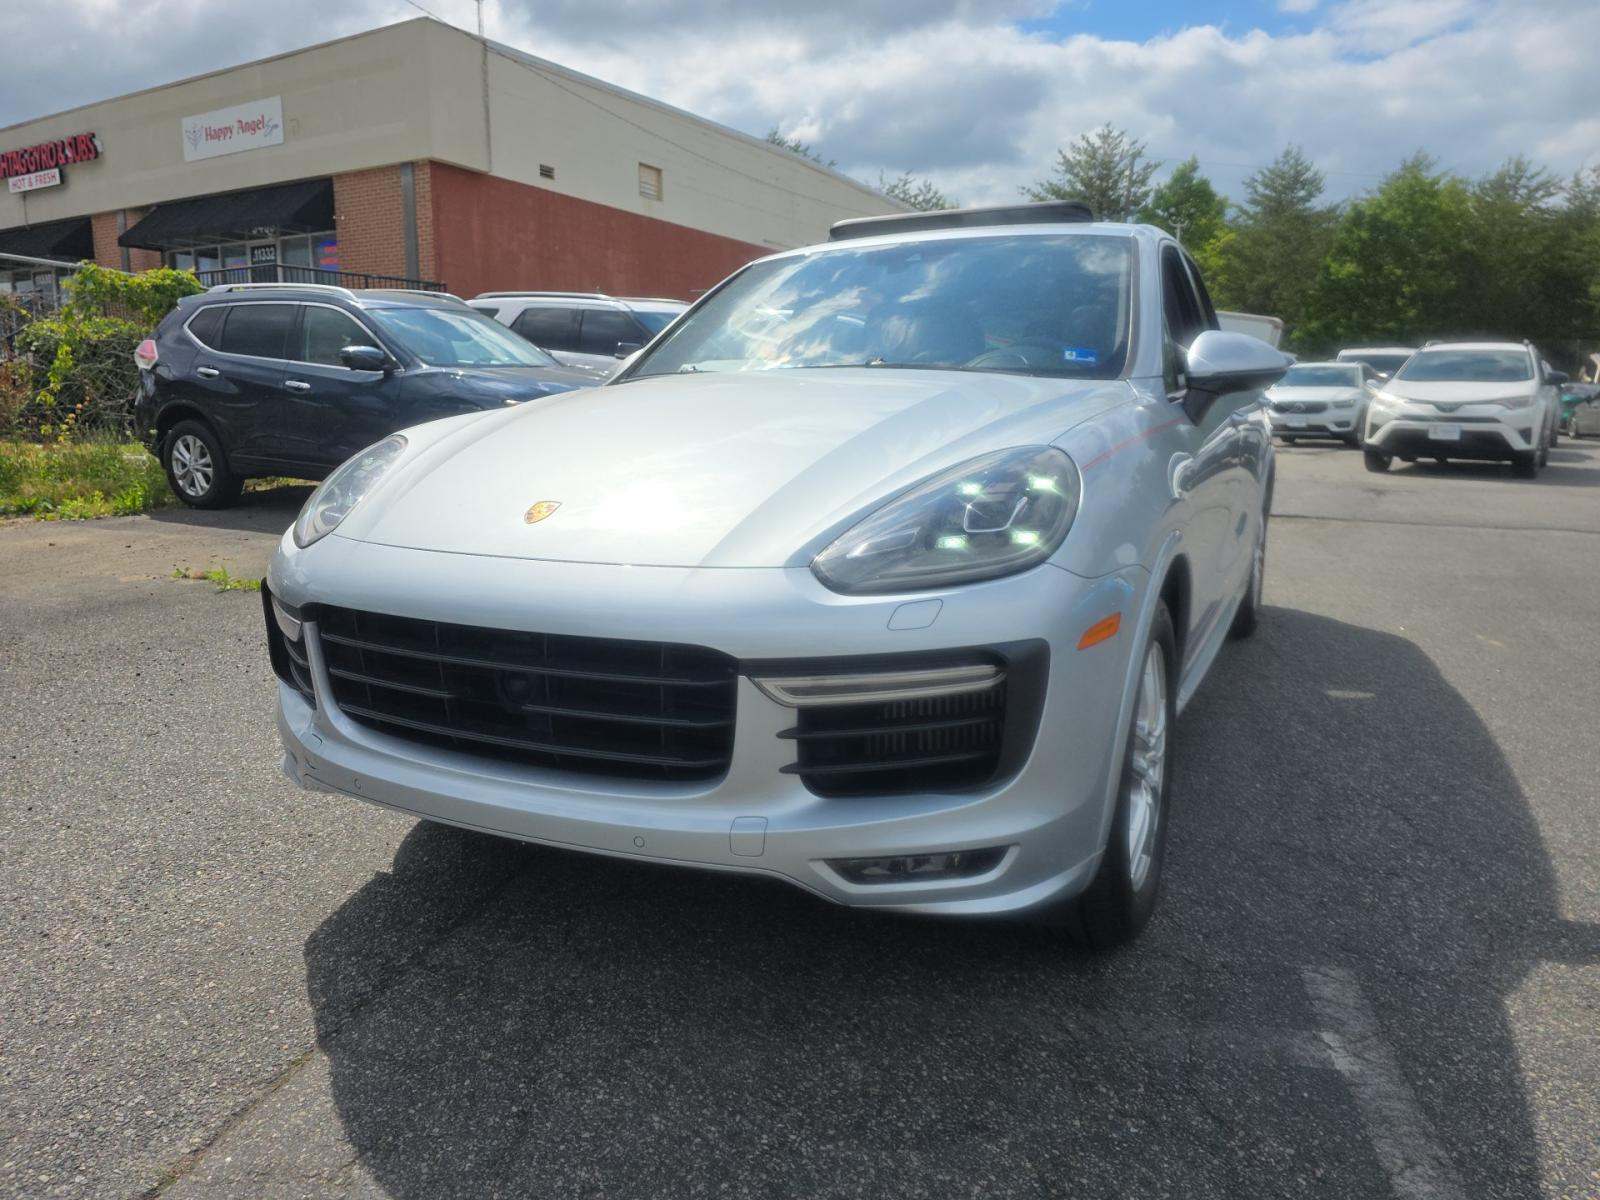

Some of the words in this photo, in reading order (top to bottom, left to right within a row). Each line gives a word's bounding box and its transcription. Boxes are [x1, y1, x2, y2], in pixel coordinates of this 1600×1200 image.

[204, 125, 233, 141] Happy
[236, 114, 265, 135] Angel
[26, 141, 57, 173] GYRO
[57, 140, 66, 165] &
[65, 132, 96, 164] SUBS
[11, 177, 25, 190] HOT
[35, 172, 57, 186] FRESH
[254, 247, 275, 262] 11332
